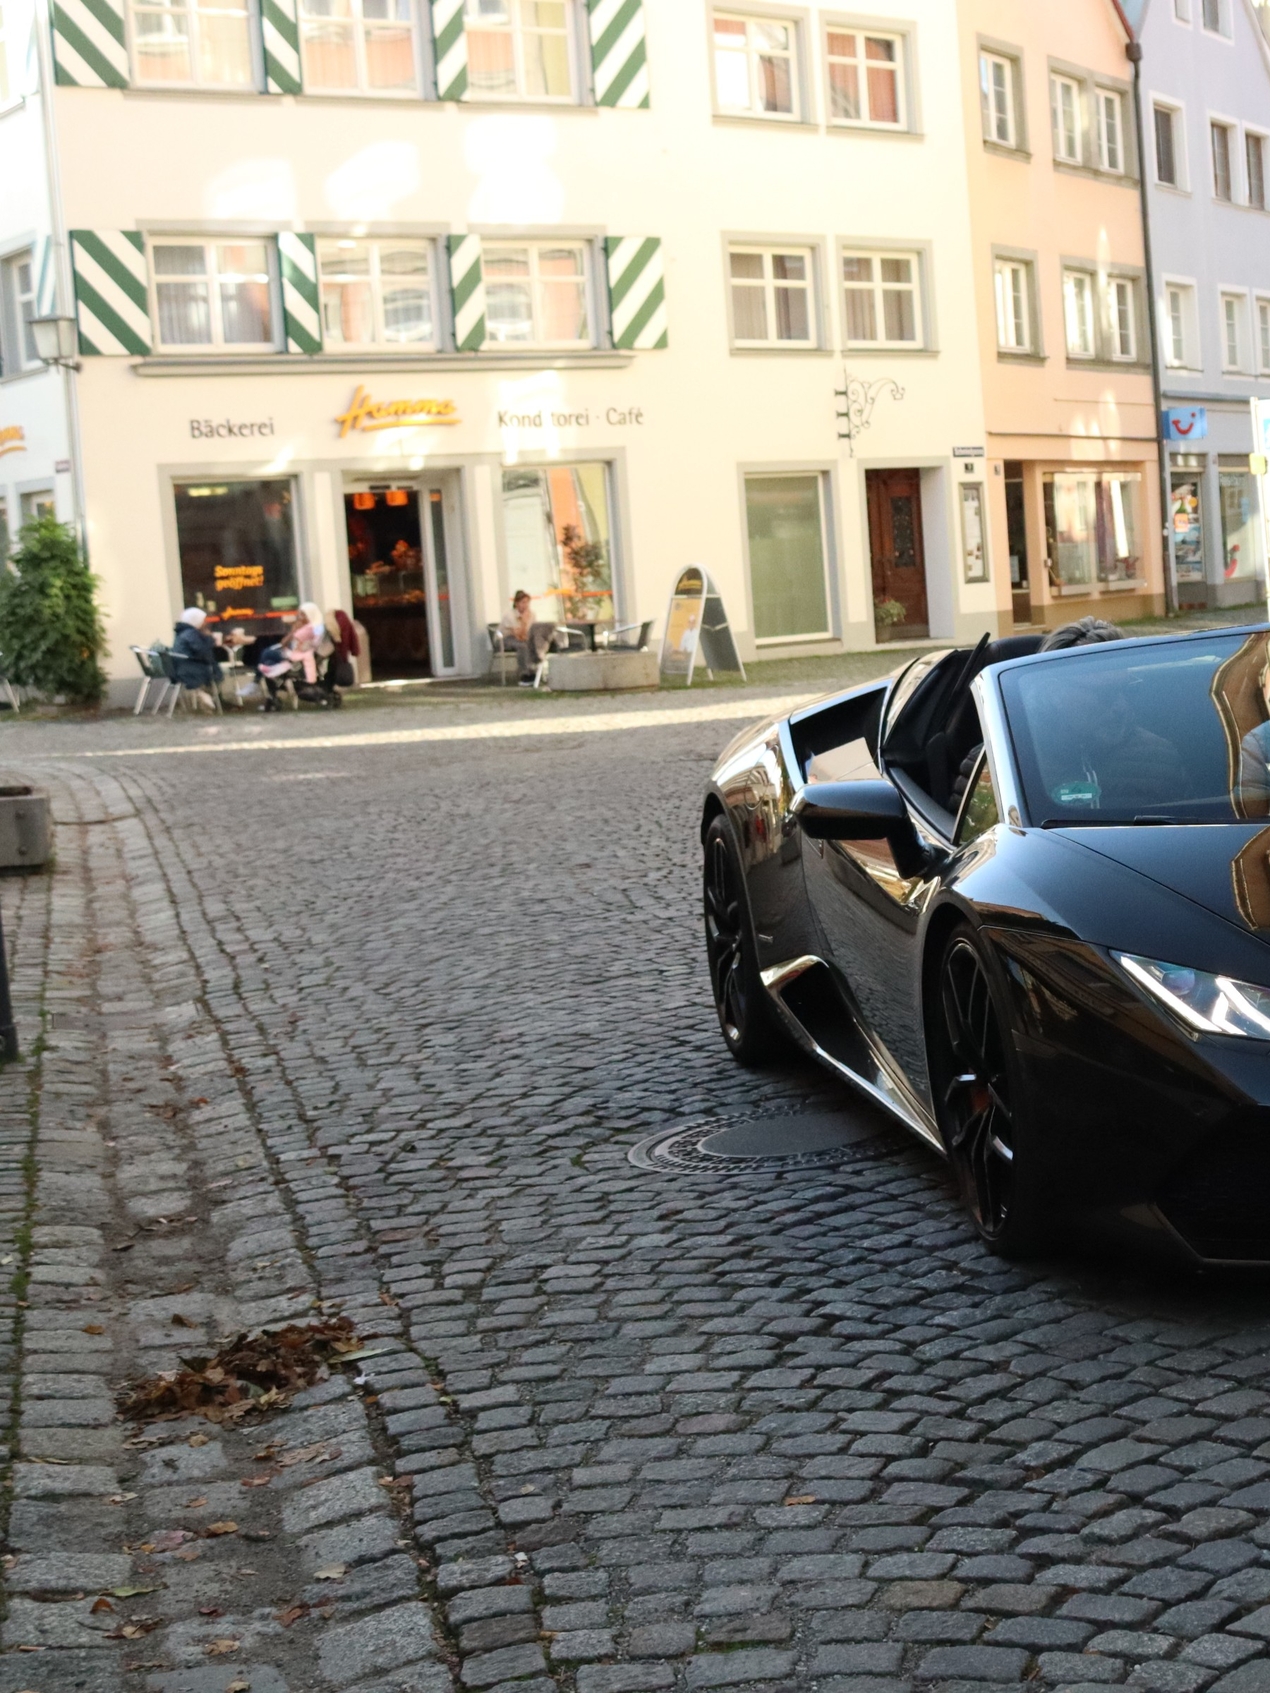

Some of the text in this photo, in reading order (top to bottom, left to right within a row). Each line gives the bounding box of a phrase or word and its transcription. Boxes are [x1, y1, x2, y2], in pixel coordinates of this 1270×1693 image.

[190, 416, 275, 439] Bäckerei
[497, 406, 645, 428] Kondtorei Café
